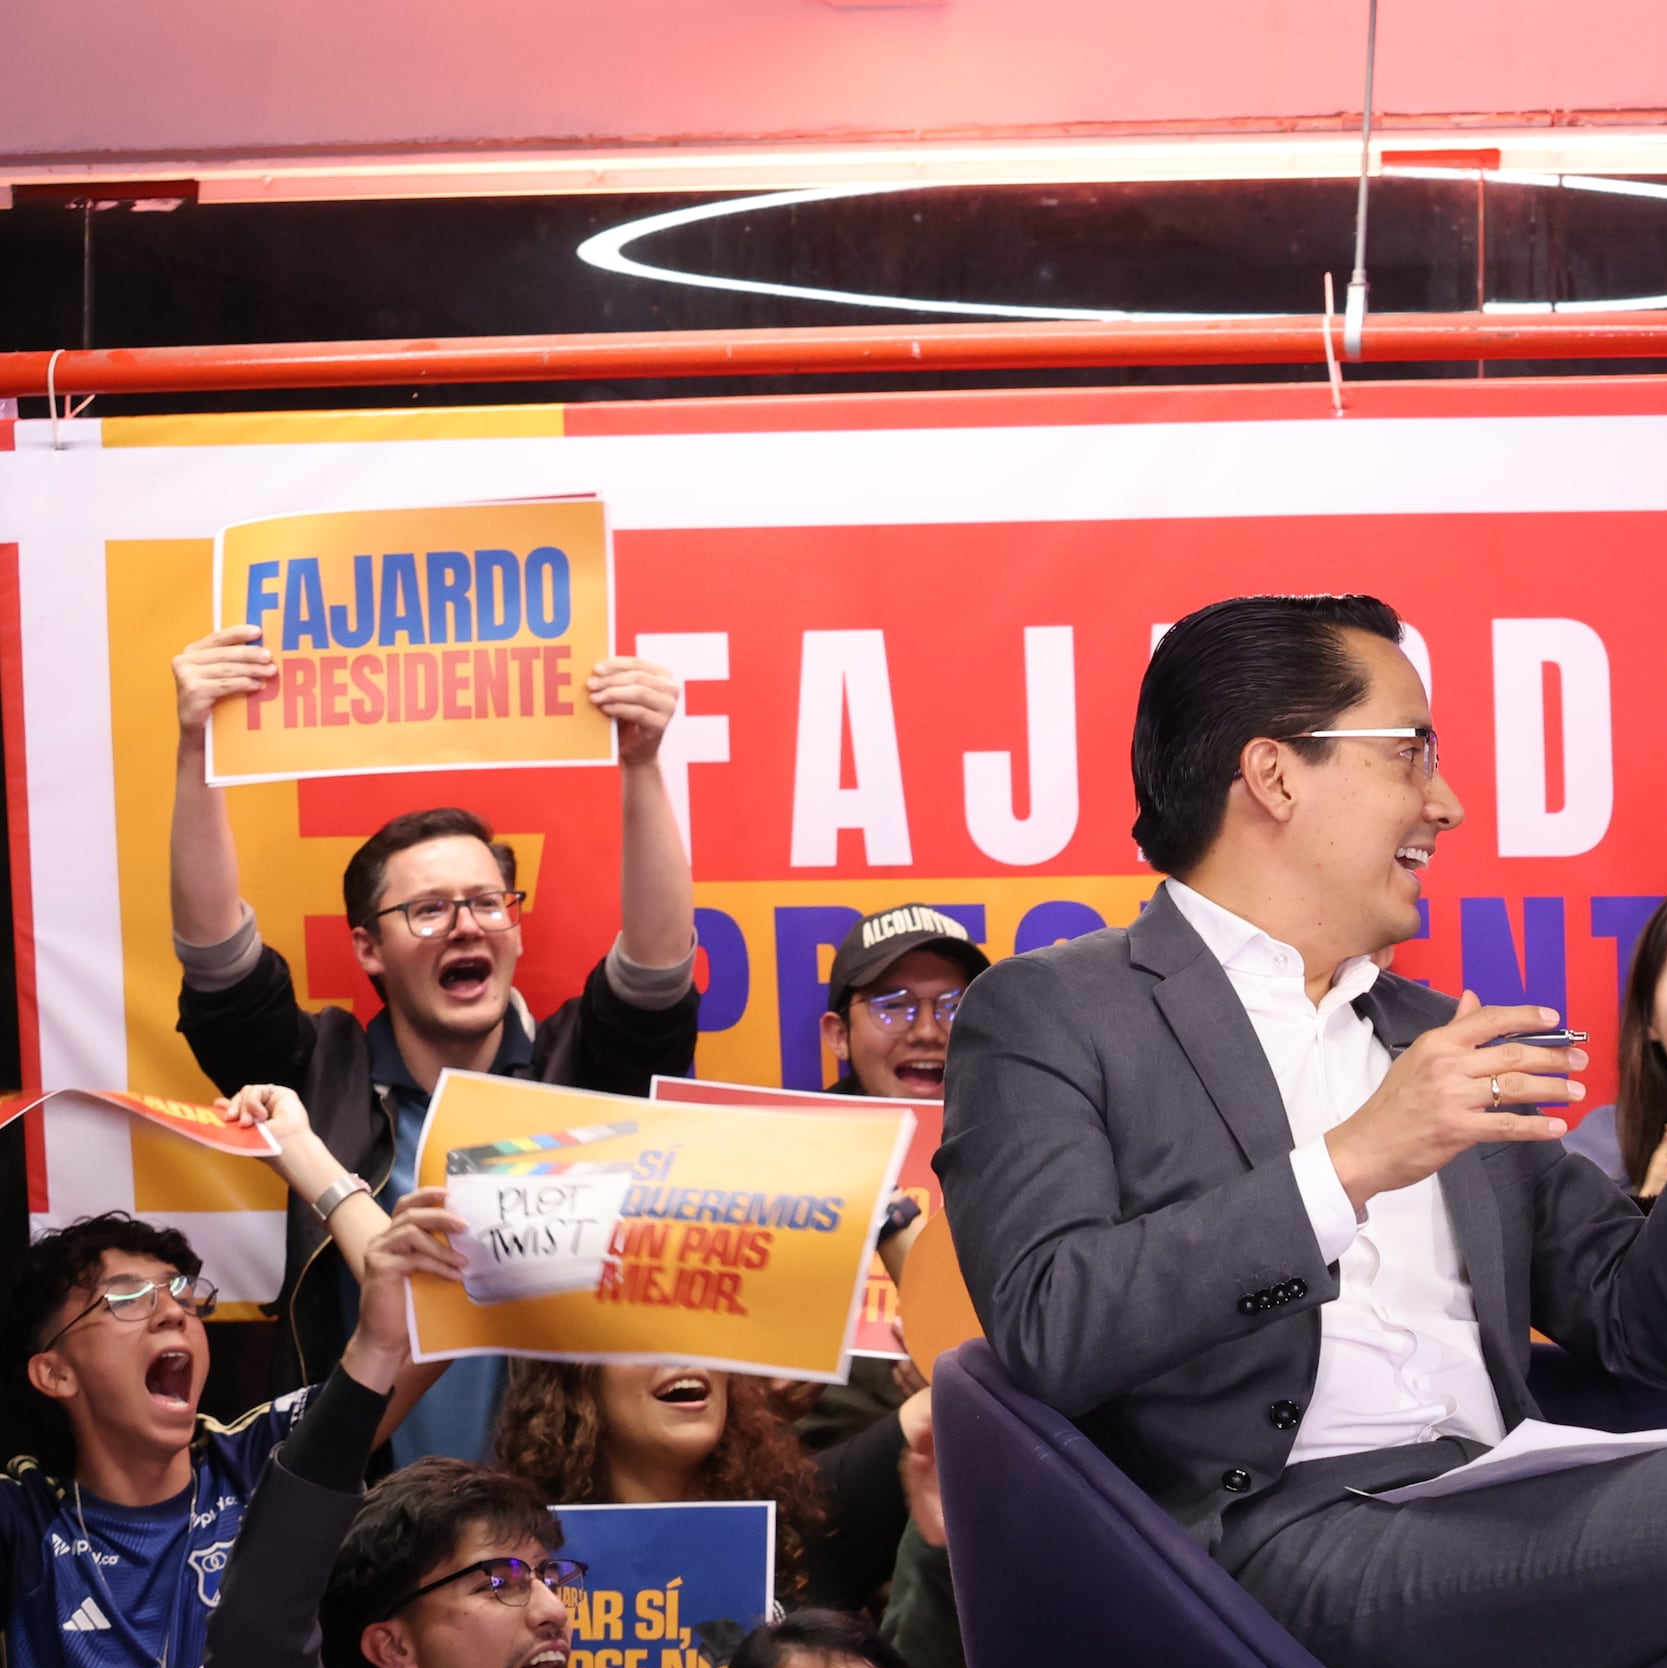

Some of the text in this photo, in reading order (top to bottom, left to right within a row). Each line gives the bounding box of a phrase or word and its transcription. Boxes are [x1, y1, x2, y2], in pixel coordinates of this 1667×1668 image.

[246, 546, 571, 651] FAJARDO
[246, 645, 574, 731] PRESIDENTE
[632, 1144, 683, 1182] SÍ
[497, 1184, 593, 1223] PLOT
[619, 1184, 845, 1233] QUEREMOS
[478, 1218, 598, 1264] TWIST
[606, 1217, 775, 1270] UN PAÍS
[633, 1576, 693, 1650] SÍ,
